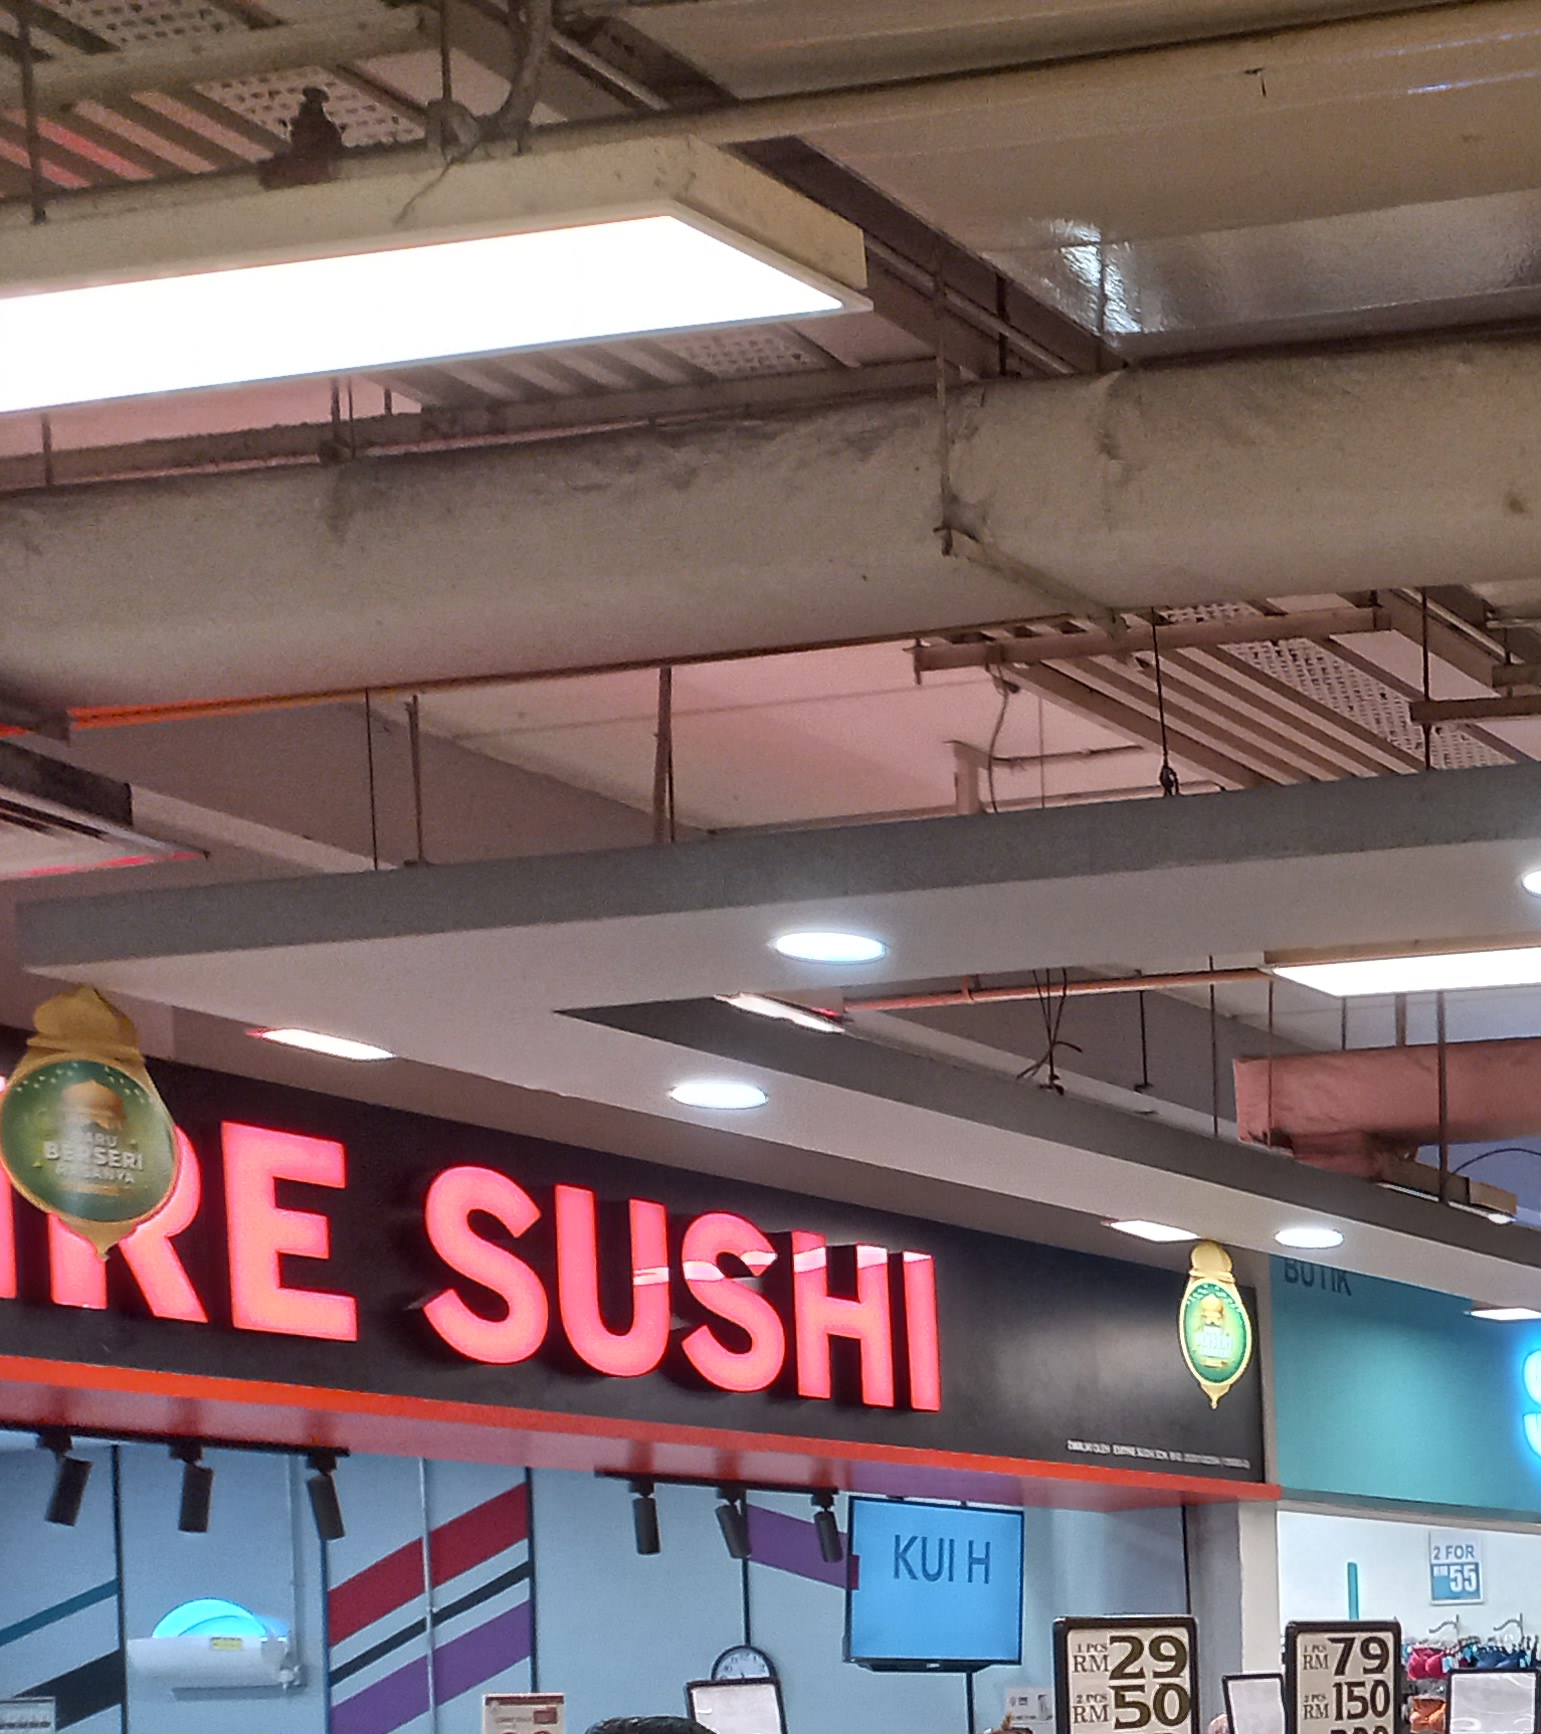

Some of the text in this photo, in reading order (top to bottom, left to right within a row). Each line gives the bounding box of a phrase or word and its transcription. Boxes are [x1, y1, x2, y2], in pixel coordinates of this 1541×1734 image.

[0, 1075, 941, 1412] RE SUSHI
[1433, 1545, 1475, 1560] 2 FOR
[1449, 1564, 1478, 1594] 55
[1072, 1635, 1188, 1680] RM 29
[1077, 1643, 1108, 1653] 1 PCS
[1303, 1636, 1390, 1676] RM 79
[1072, 1683, 1191, 1730] RM 50
[1086, 1694, 1108, 1704] PCS
[1303, 1679, 1391, 1721] RM 150
